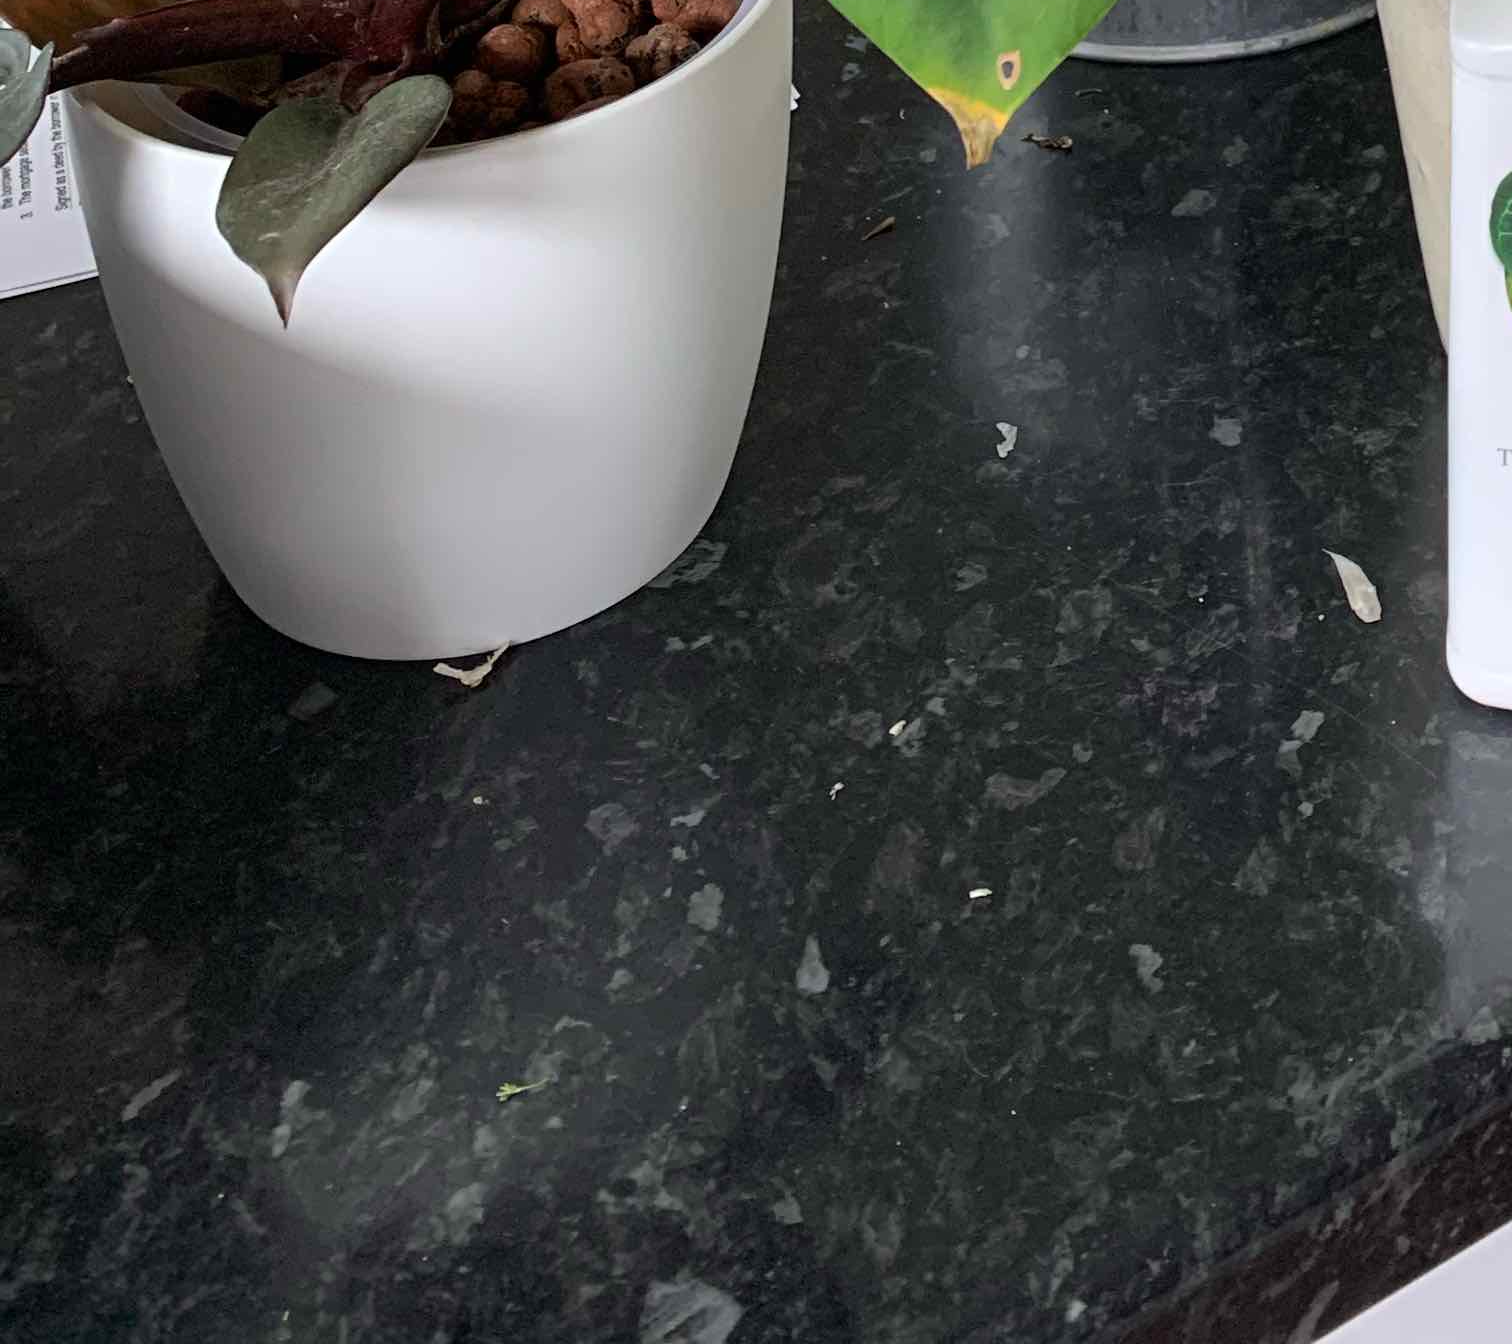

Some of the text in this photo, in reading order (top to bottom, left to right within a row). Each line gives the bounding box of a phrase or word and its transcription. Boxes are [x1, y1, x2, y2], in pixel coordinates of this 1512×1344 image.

[50, 131, 62, 142] the
[55, 176, 66, 185] as
[55, 186, 70, 211] Signed
